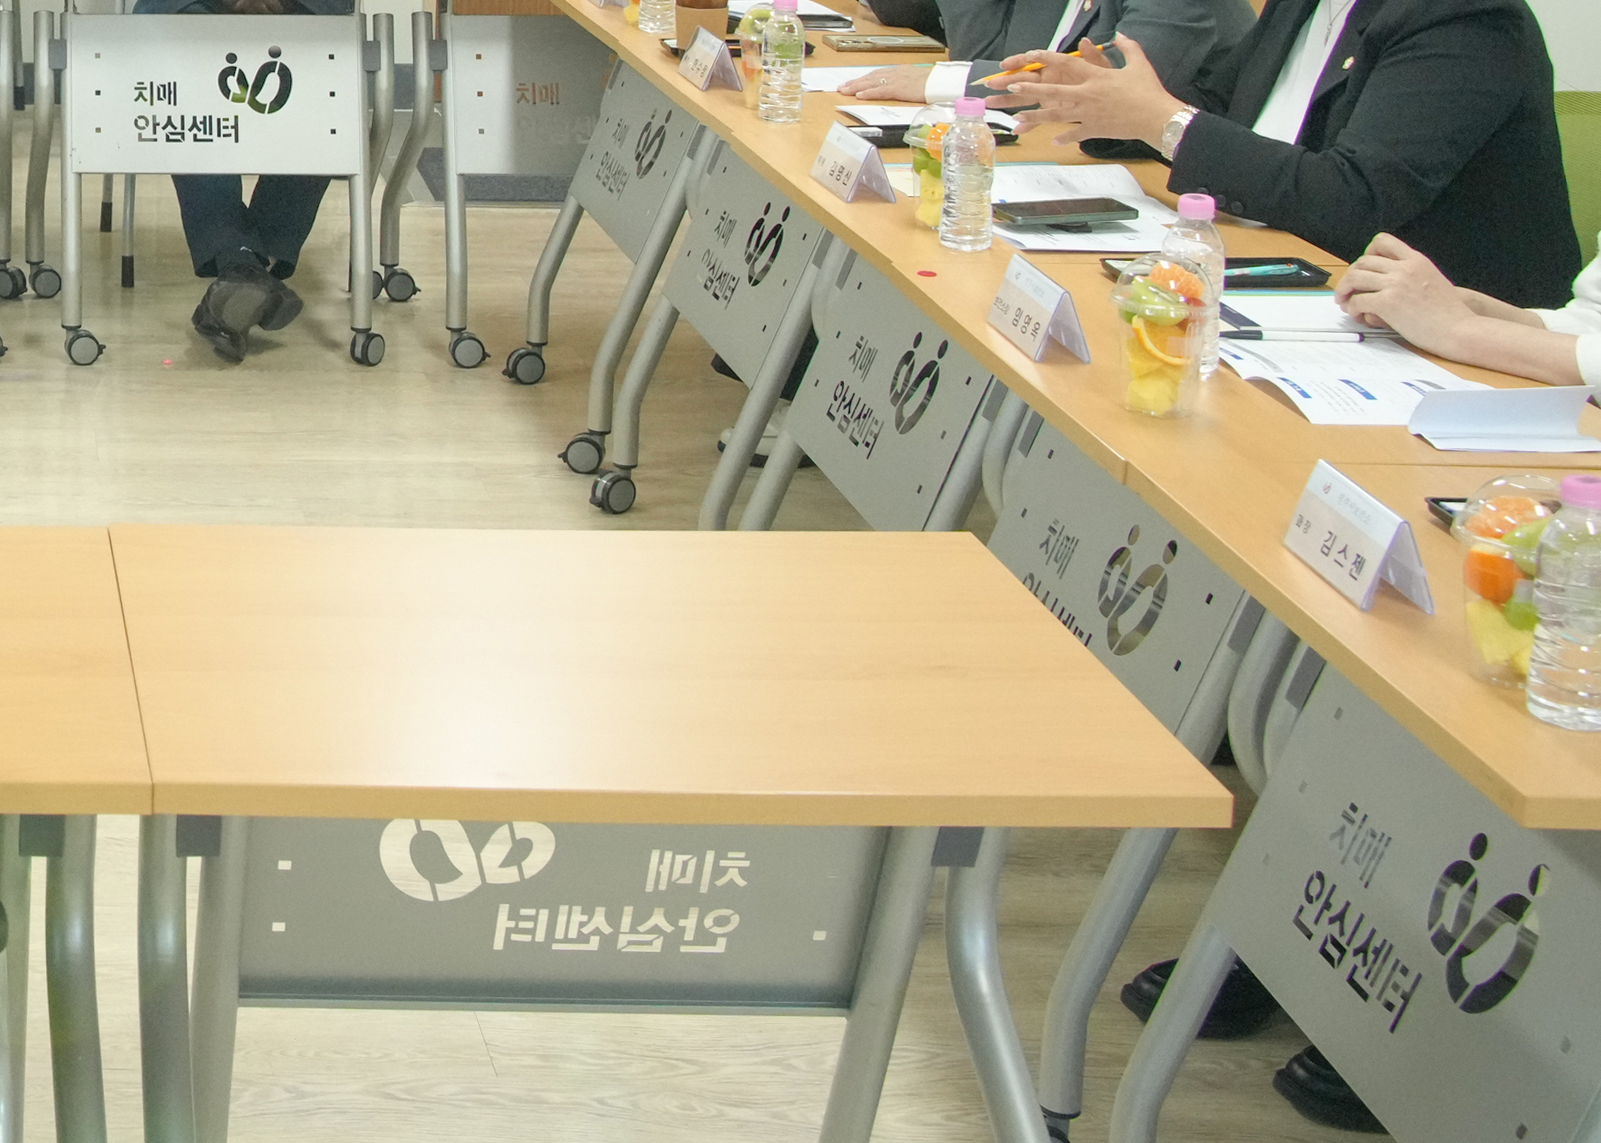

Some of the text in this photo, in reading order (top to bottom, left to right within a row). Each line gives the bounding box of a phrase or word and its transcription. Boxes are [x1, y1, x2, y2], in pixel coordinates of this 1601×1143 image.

[134, 81, 177, 106] 치매
[516, 82, 560, 105] 치매
[134, 114, 239, 143] 안심센터
[596, 151, 630, 201] 안심센터
[829, 160, 853, 186] 김명신
[701, 248, 740, 310] 안심센터
[1011, 307, 1041, 342] 임영옥
[848, 336, 878, 383] 치매
[826, 380, 885, 460] 안심센터
[1039, 518, 1079, 580] 치매
[1320, 530, 1367, 581] 김스젠
[1329, 802, 1393, 889] 치매
[1292, 870, 1422, 1034] 안심센터
